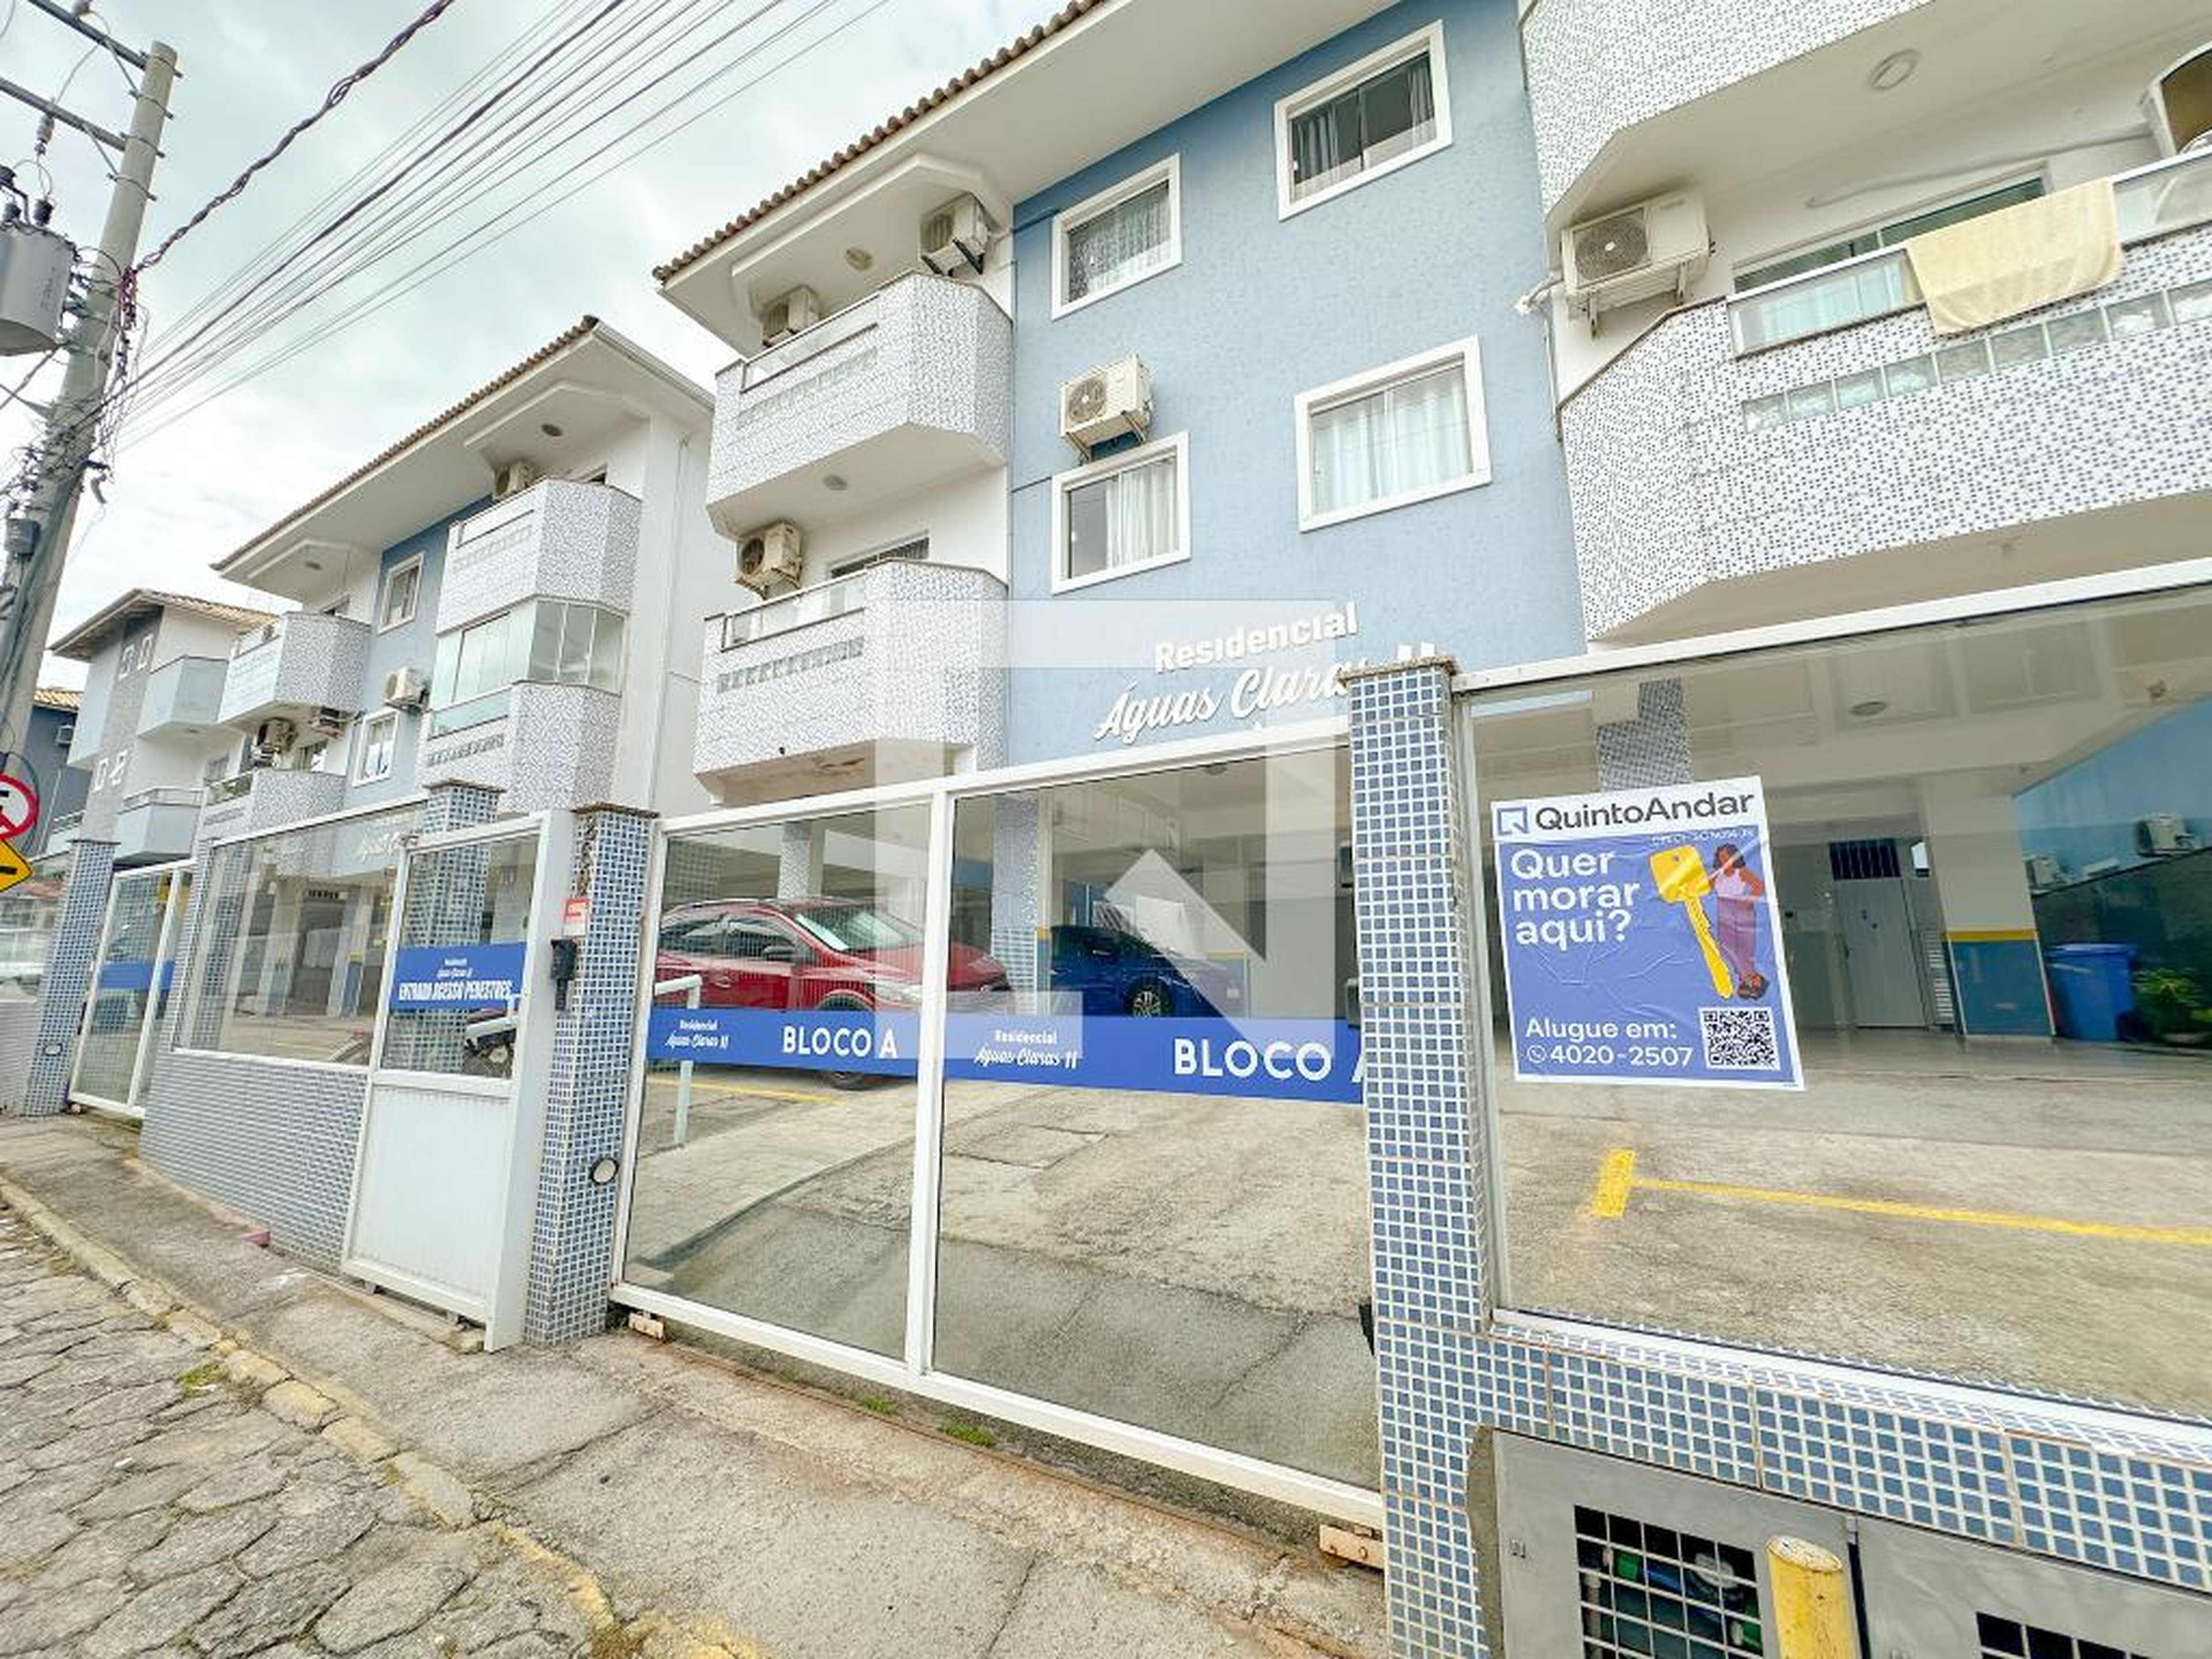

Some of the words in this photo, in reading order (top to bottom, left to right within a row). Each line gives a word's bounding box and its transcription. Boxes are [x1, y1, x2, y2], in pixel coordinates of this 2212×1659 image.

[1155, 603, 1358, 673] Residencial
[1093, 676, 1225, 744] Águas
[1230, 658, 1368, 719] Clara
[1535, 792, 1755, 831] QuintoAndar
[1510, 849, 1614, 880] Quer
[1513, 882, 1639, 912] morar
[1515, 911, 1631, 951] aqui?
[783, 1025, 872, 1056] BLOCO
[878, 1029, 897, 1059] A
[994, 1029, 1057, 1044] Residencial
[1525, 1018, 1618, 1042] Alugue
[1626, 1022, 1677, 1039] em:
[1175, 1039, 1332, 1082] BLOCO
[1550, 1044, 1694, 1067] 4020-2507
